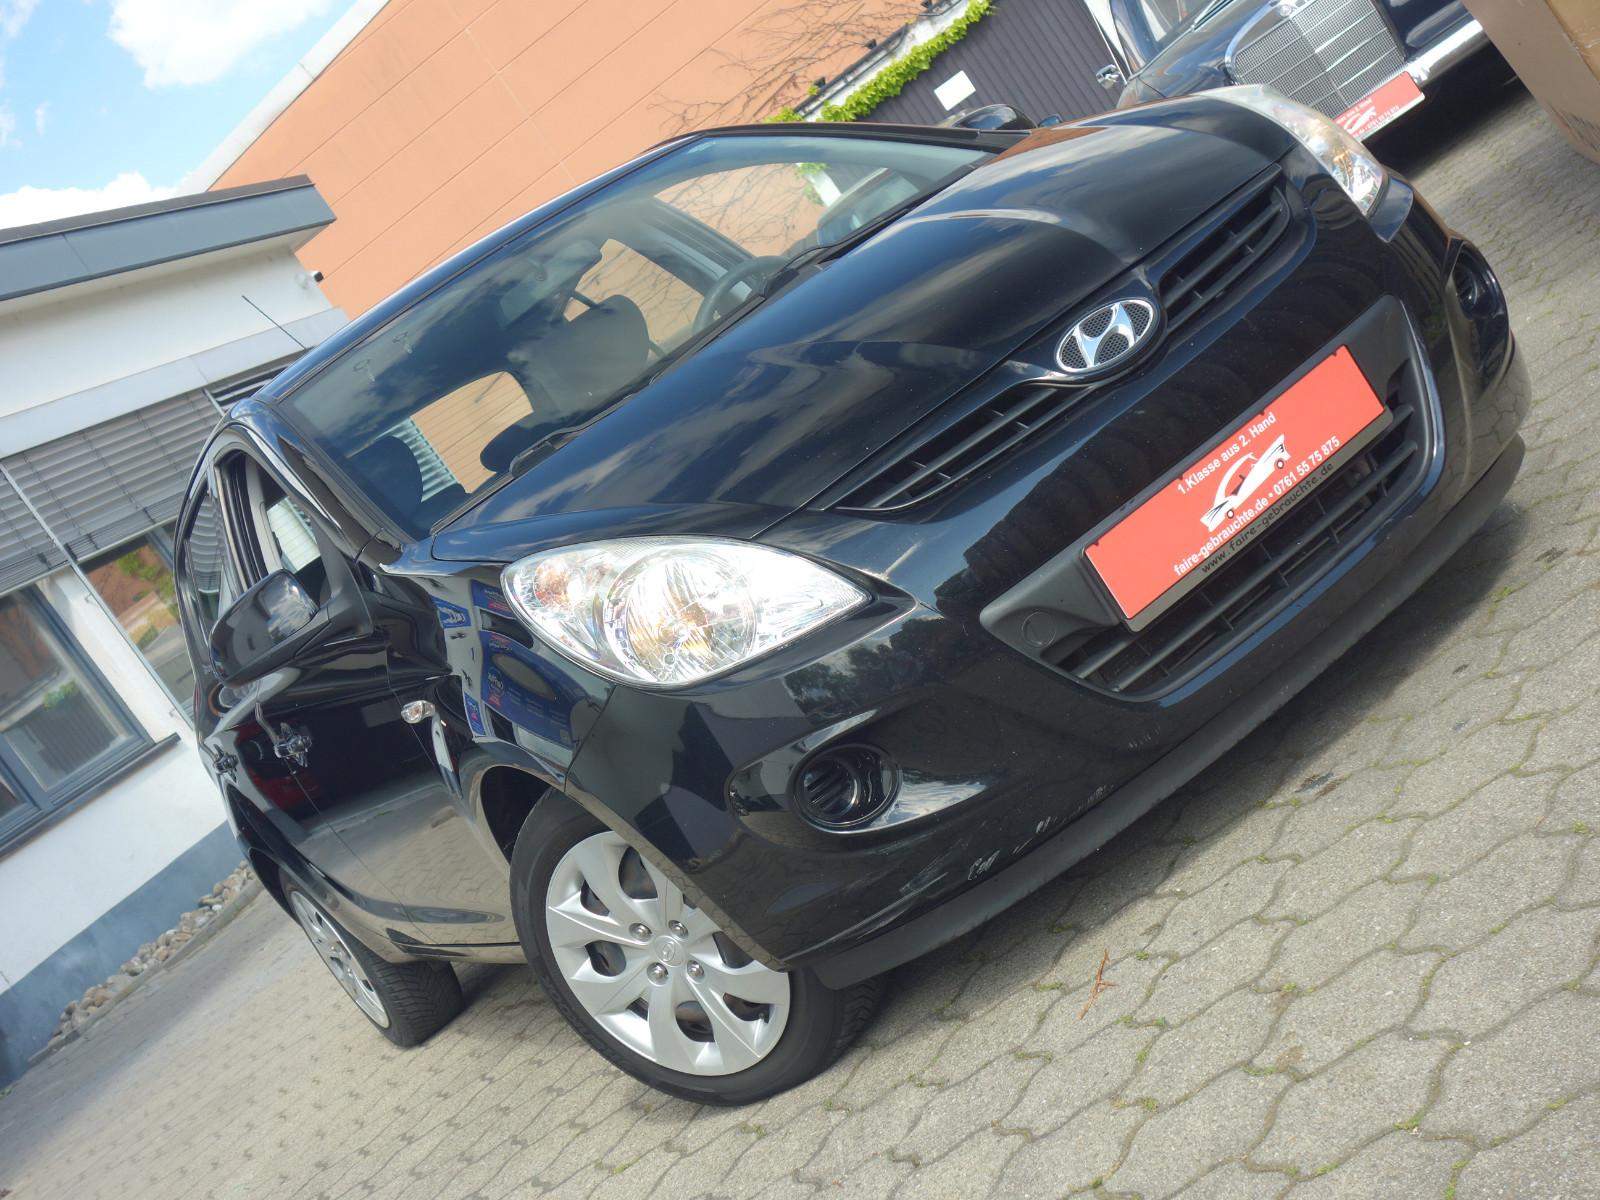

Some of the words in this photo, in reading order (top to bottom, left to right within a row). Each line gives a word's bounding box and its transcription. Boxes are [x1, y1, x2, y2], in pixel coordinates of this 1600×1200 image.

[1174, 496, 1269, 576] faire-gebrauchte.de
[1273, 471, 1297, 495] 0761
[1296, 460, 1310, 476] 55
[1308, 450, 1323, 466] 75
[1321, 435, 1340, 455] 875
[1178, 459, 1221, 495] 1.Klasse
[1222, 442, 1240, 461] aus
[1239, 434, 1251, 447] 2.
[1249, 412, 1276, 438] Hand
